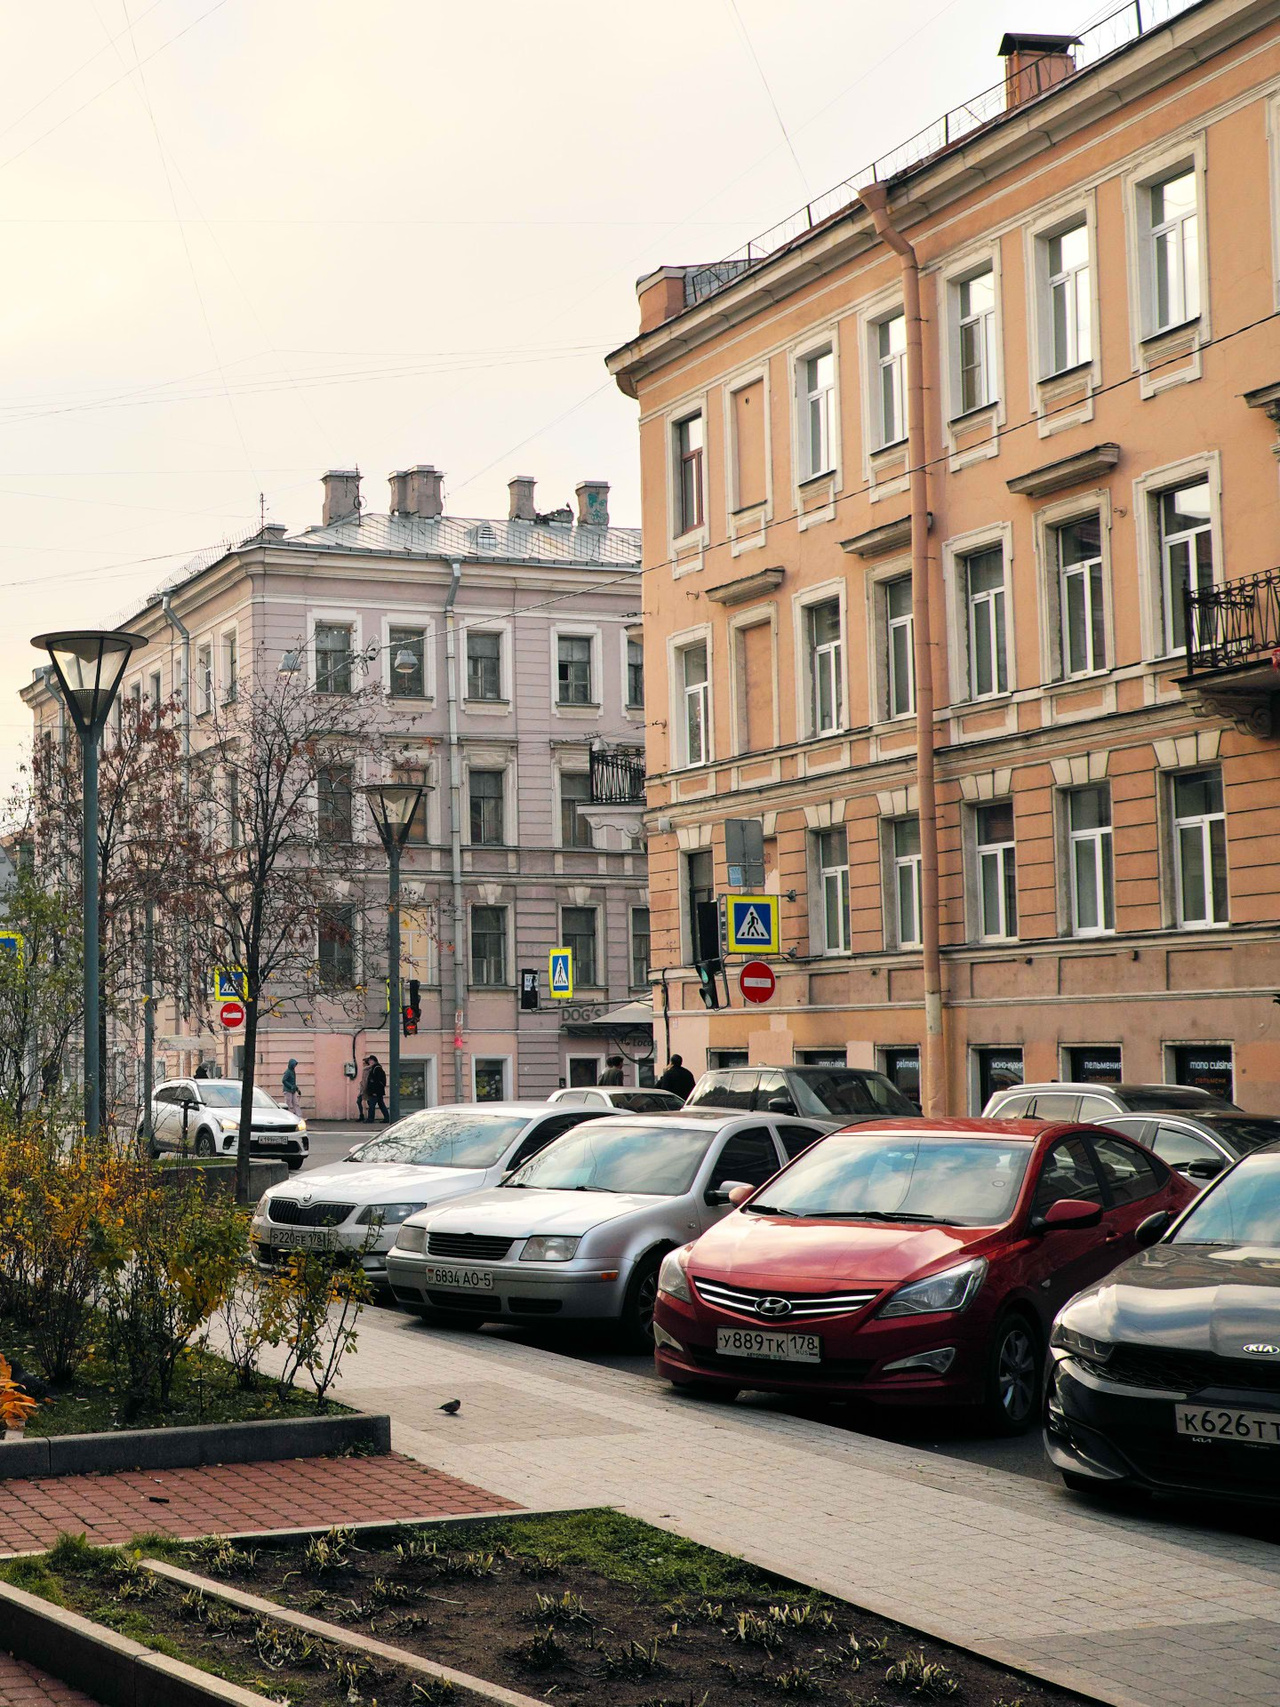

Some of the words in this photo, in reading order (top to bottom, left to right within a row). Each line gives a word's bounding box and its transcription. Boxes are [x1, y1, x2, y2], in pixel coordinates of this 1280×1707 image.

[896, 1059, 919, 1070] pelmeny
[1190, 1061, 1209, 1069] mono
[1210, 1060, 1233, 1069] cuisine
[435, 1269, 459, 1284] 6834
[723, 1331, 786, 1353] У889ТК
[790, 1336, 815, 1350] 178
[1248, 1344, 1274, 1353] KIA
